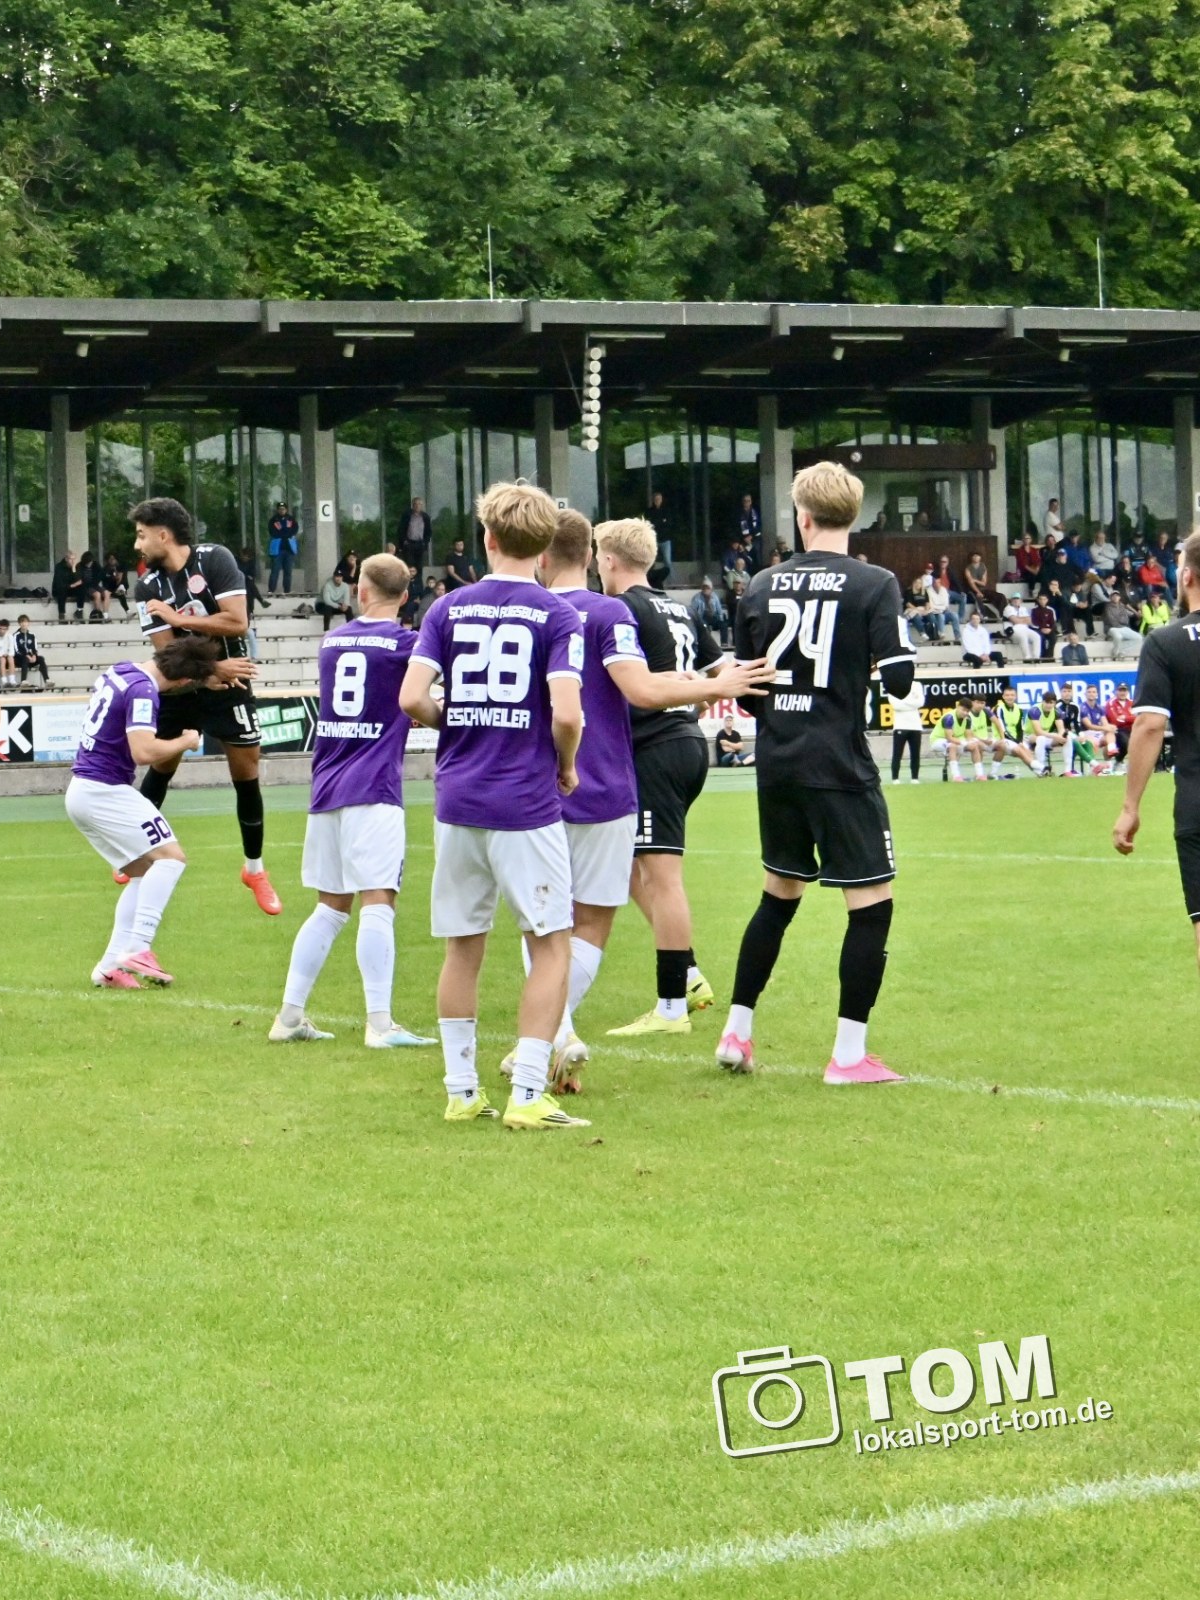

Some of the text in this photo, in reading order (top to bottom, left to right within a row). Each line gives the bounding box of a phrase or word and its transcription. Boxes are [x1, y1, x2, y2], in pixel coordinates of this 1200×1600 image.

[321, 503, 331, 517] C
[771, 573, 847, 592] TSV 1882
[448, 604, 550, 624] SCHWABEN AUGSBURG
[766, 598, 839, 689] 24
[450, 623, 534, 704] 28
[331, 651, 368, 717] 8
[774, 693, 813, 712] KUHN
[233, 704, 253, 732] 4
[446, 706, 531, 729] ESCHWEILER
[316, 720, 384, 739] SCHWARZHOLZ
[140, 815, 172, 846] 30
